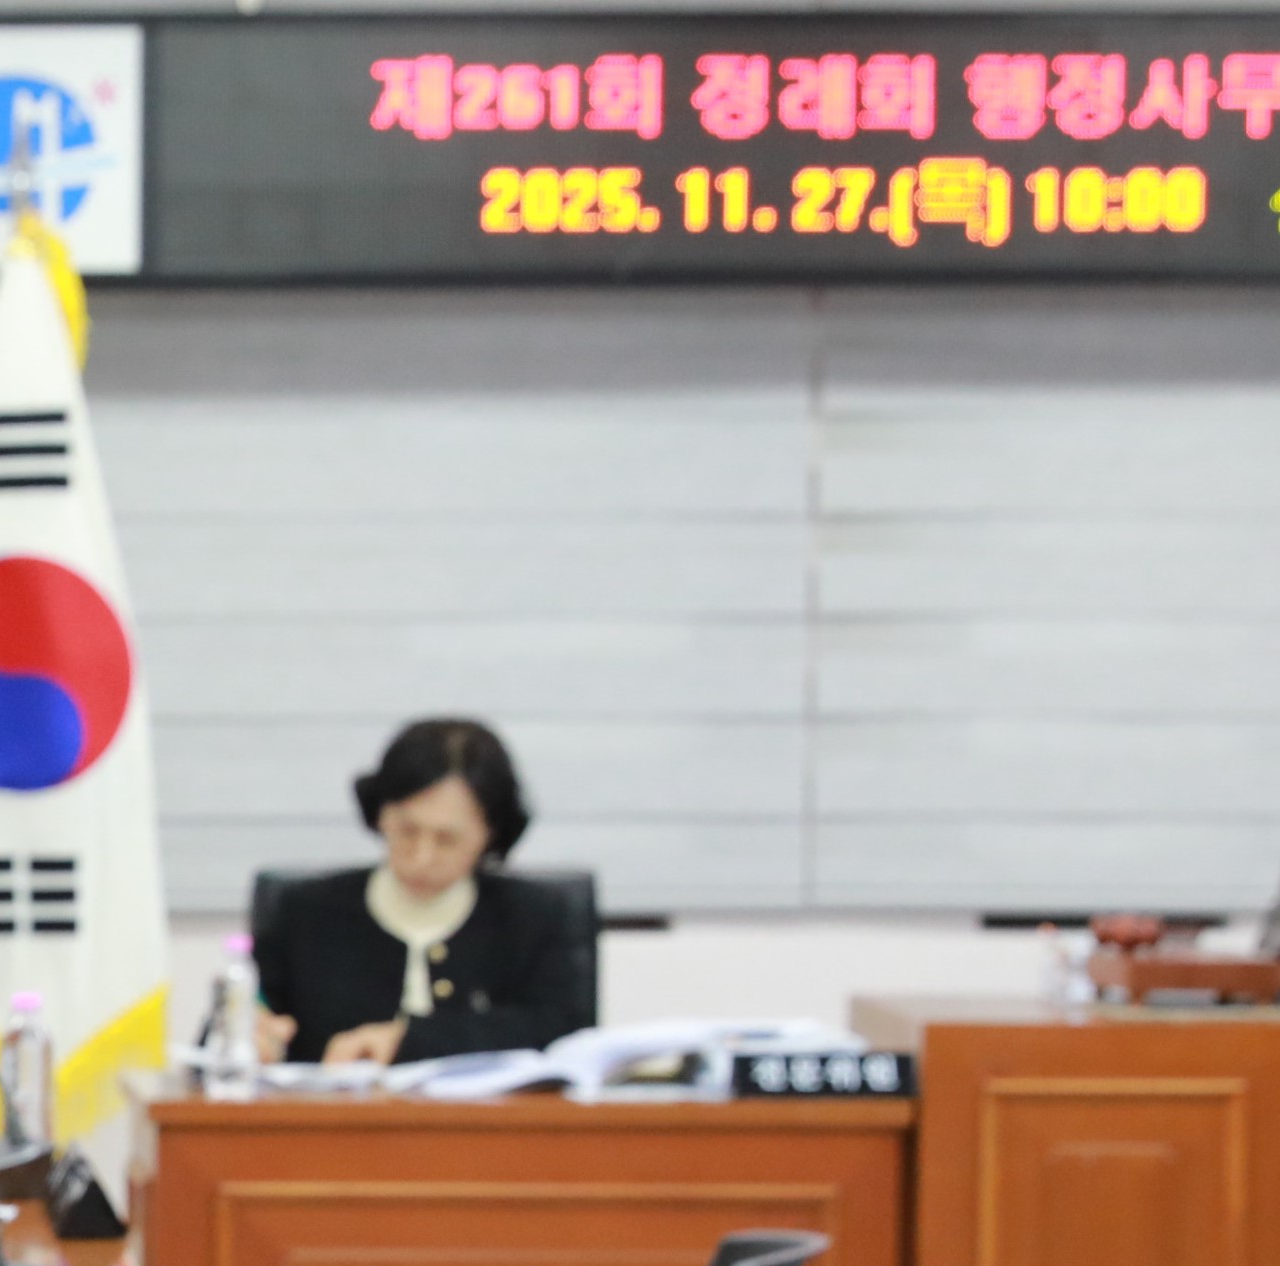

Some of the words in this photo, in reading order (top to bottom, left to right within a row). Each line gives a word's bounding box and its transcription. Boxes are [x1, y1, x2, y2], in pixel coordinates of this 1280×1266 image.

[369, 53, 664, 140] 제261회
[690, 53, 936, 140] 정례회
[963, 53, 1280, 140] 행정사무
[480, 166, 660, 233] 2025.
[675, 166, 778, 233] 11.
[1025, 165, 1207, 233] 10:00
